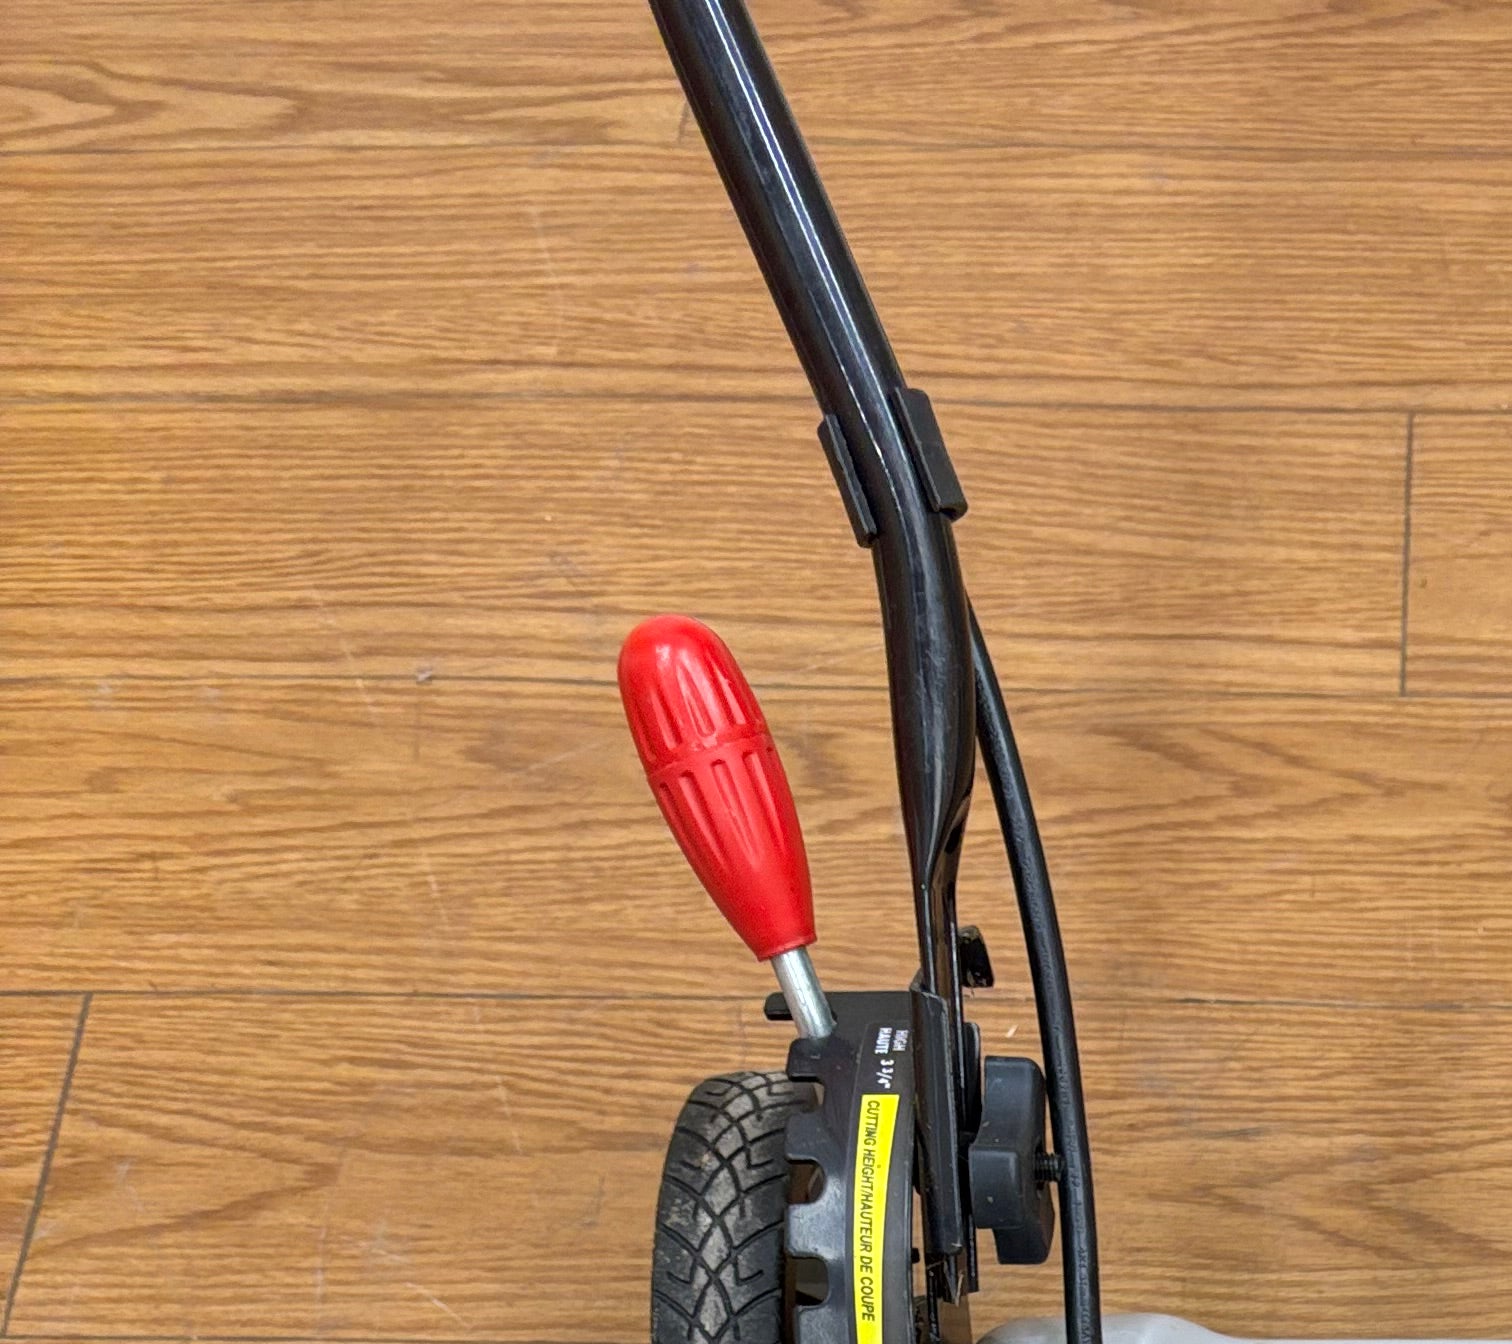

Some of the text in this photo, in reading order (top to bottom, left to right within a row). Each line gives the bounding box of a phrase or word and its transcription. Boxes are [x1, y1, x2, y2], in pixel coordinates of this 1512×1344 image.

[875, 1027, 892, 1054] HAUTE
[893, 1030, 909, 1051] HIGH
[860, 1100, 880, 1322] CUTTING HEIGHT/HAUTEUR DE COUPE
